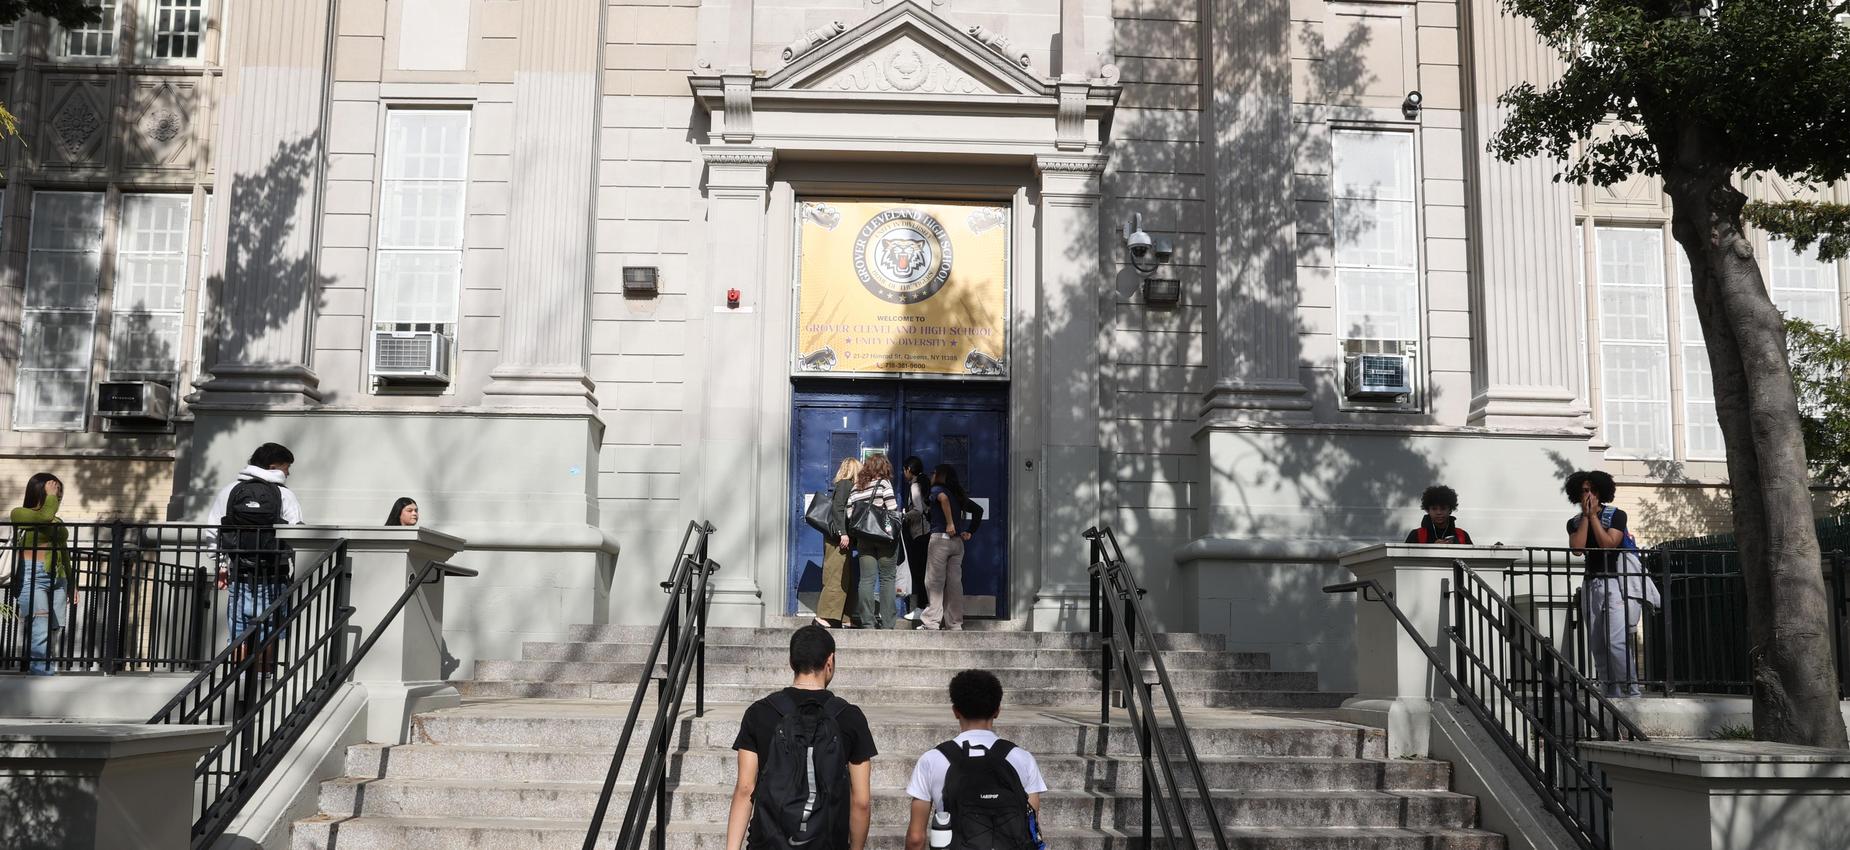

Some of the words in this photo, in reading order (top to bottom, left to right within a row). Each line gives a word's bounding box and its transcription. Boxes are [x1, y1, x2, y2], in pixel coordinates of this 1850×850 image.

[862, 209, 922, 237] CLEVELAND
[923, 215, 946, 239] HIGH
[855, 239, 870, 283] GROVER
[934, 240, 952, 282] SCHOOL
[806, 324, 849, 333] GROVER
[853, 325, 916, 335] CLEVELAND
[920, 326, 946, 336] HIGH
[949, 327, 992, 336] SCHOOL
[856, 337, 883, 345] UNITY
[898, 338, 947, 347] DIVERSITY
[842, 416, 848, 429] 1
